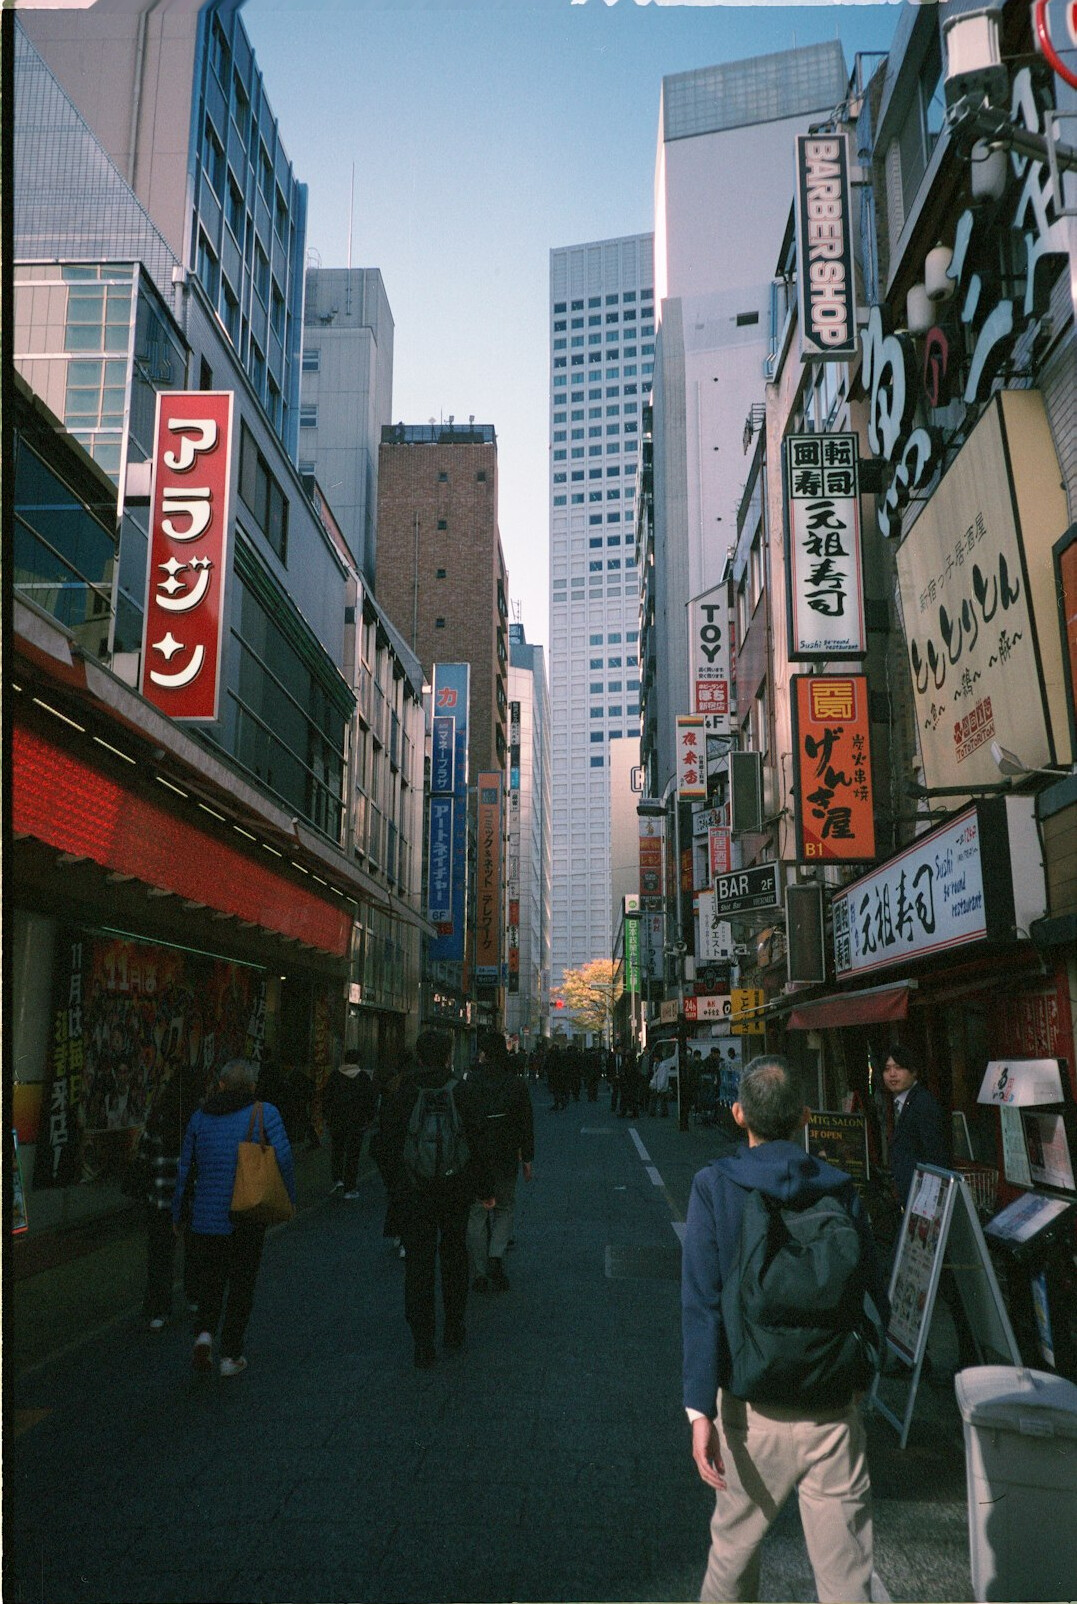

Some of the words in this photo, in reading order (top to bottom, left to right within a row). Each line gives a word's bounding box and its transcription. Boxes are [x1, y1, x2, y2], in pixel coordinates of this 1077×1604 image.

[804, 139, 848, 346] BARBERSHOP
[794, 441, 851, 467] 回転
[795, 469, 852, 496] 寿司
[149, 417, 217, 688] アラジン
[802, 501, 849, 617] 元祖寿司
[700, 604, 722, 664] TOY
[800, 640, 821, 649] Sushi
[852, 733, 869, 801] 炭火串焼
[805, 727, 855, 839] げんき屋
[433, 805, 449, 902] アートネイチャー
[805, 842, 824, 856] B1
[718, 874, 749, 901] BAR
[761, 879, 774, 892] 2F
[432, 910, 447, 921] 6F
[860, 863, 936, 956] 元祖寿司
[684, 999, 697, 1010] 24h
[809, 1115, 830, 1126] MTG
[831, 1117, 864, 1128] SALON
[820, 1129, 843, 1140] OPEN
